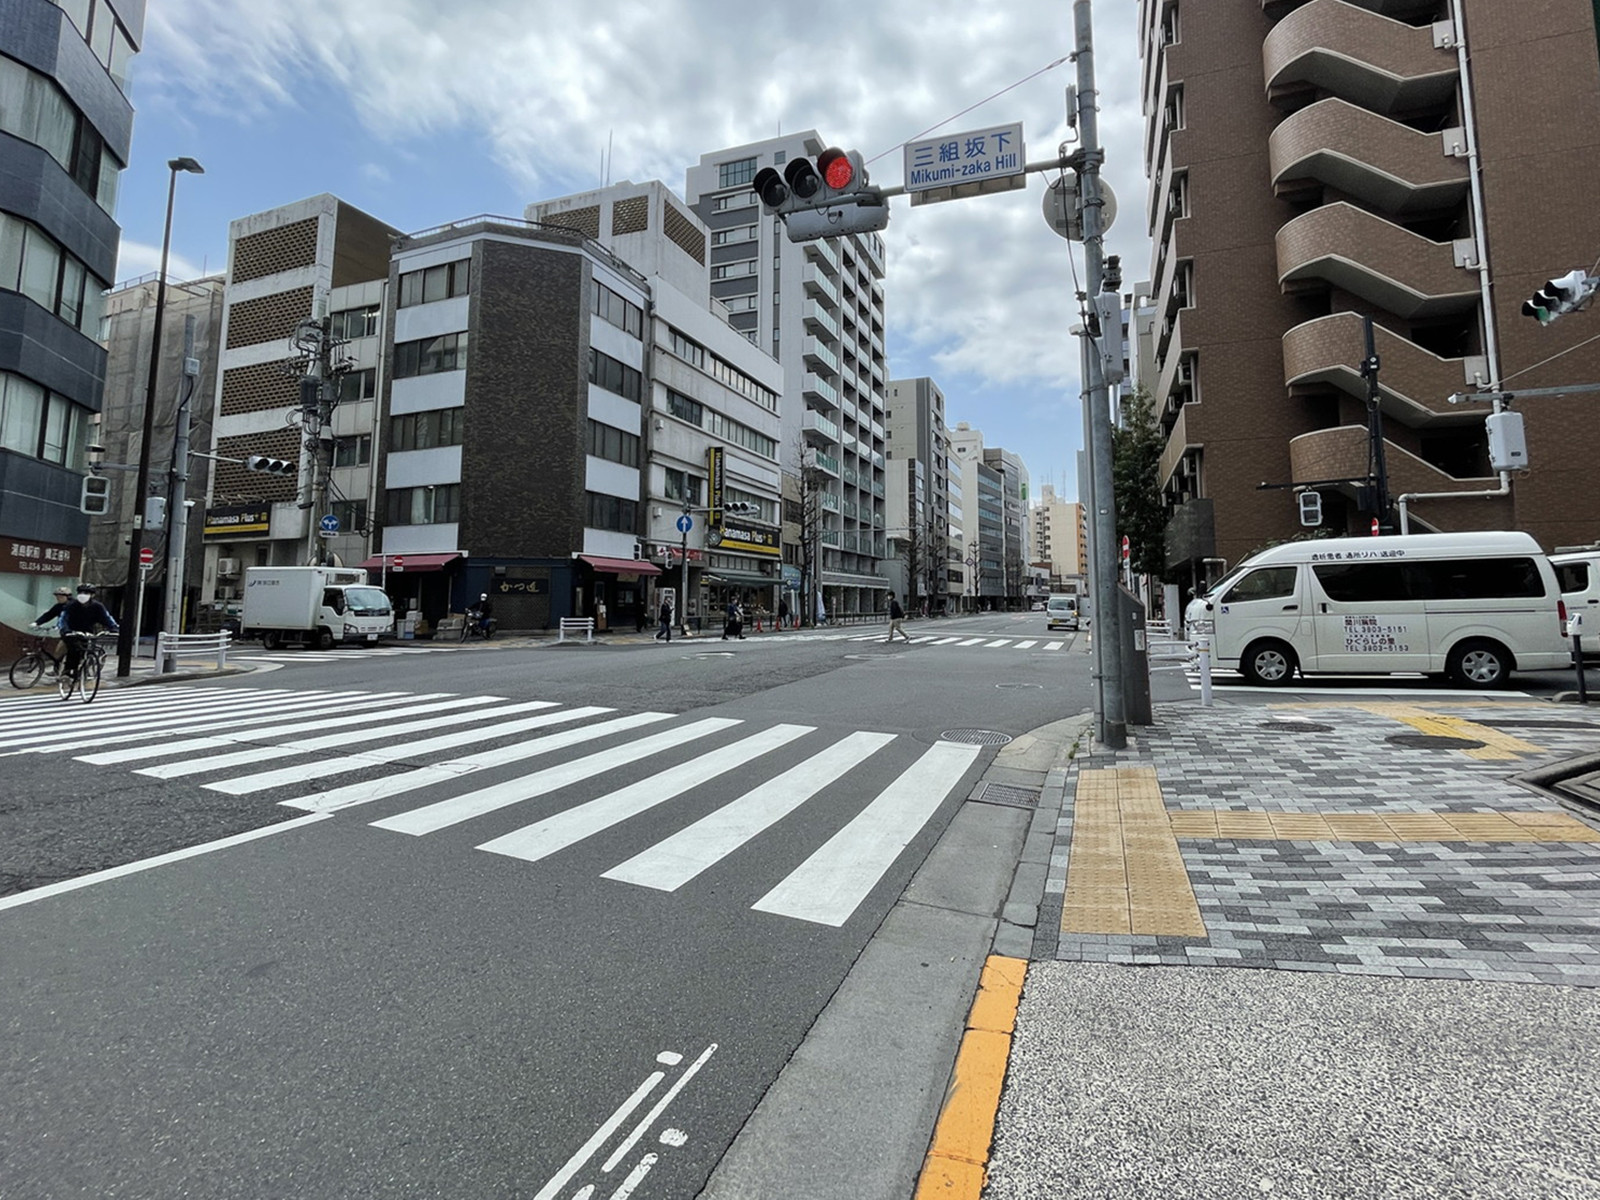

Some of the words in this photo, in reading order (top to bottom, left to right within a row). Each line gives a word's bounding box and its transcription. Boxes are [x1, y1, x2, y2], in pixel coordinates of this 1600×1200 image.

[914, 131, 1012, 167] 三組坂下
[911, 160, 992, 185] Mikumi-zaka
[995, 152, 1017, 171] Hill
